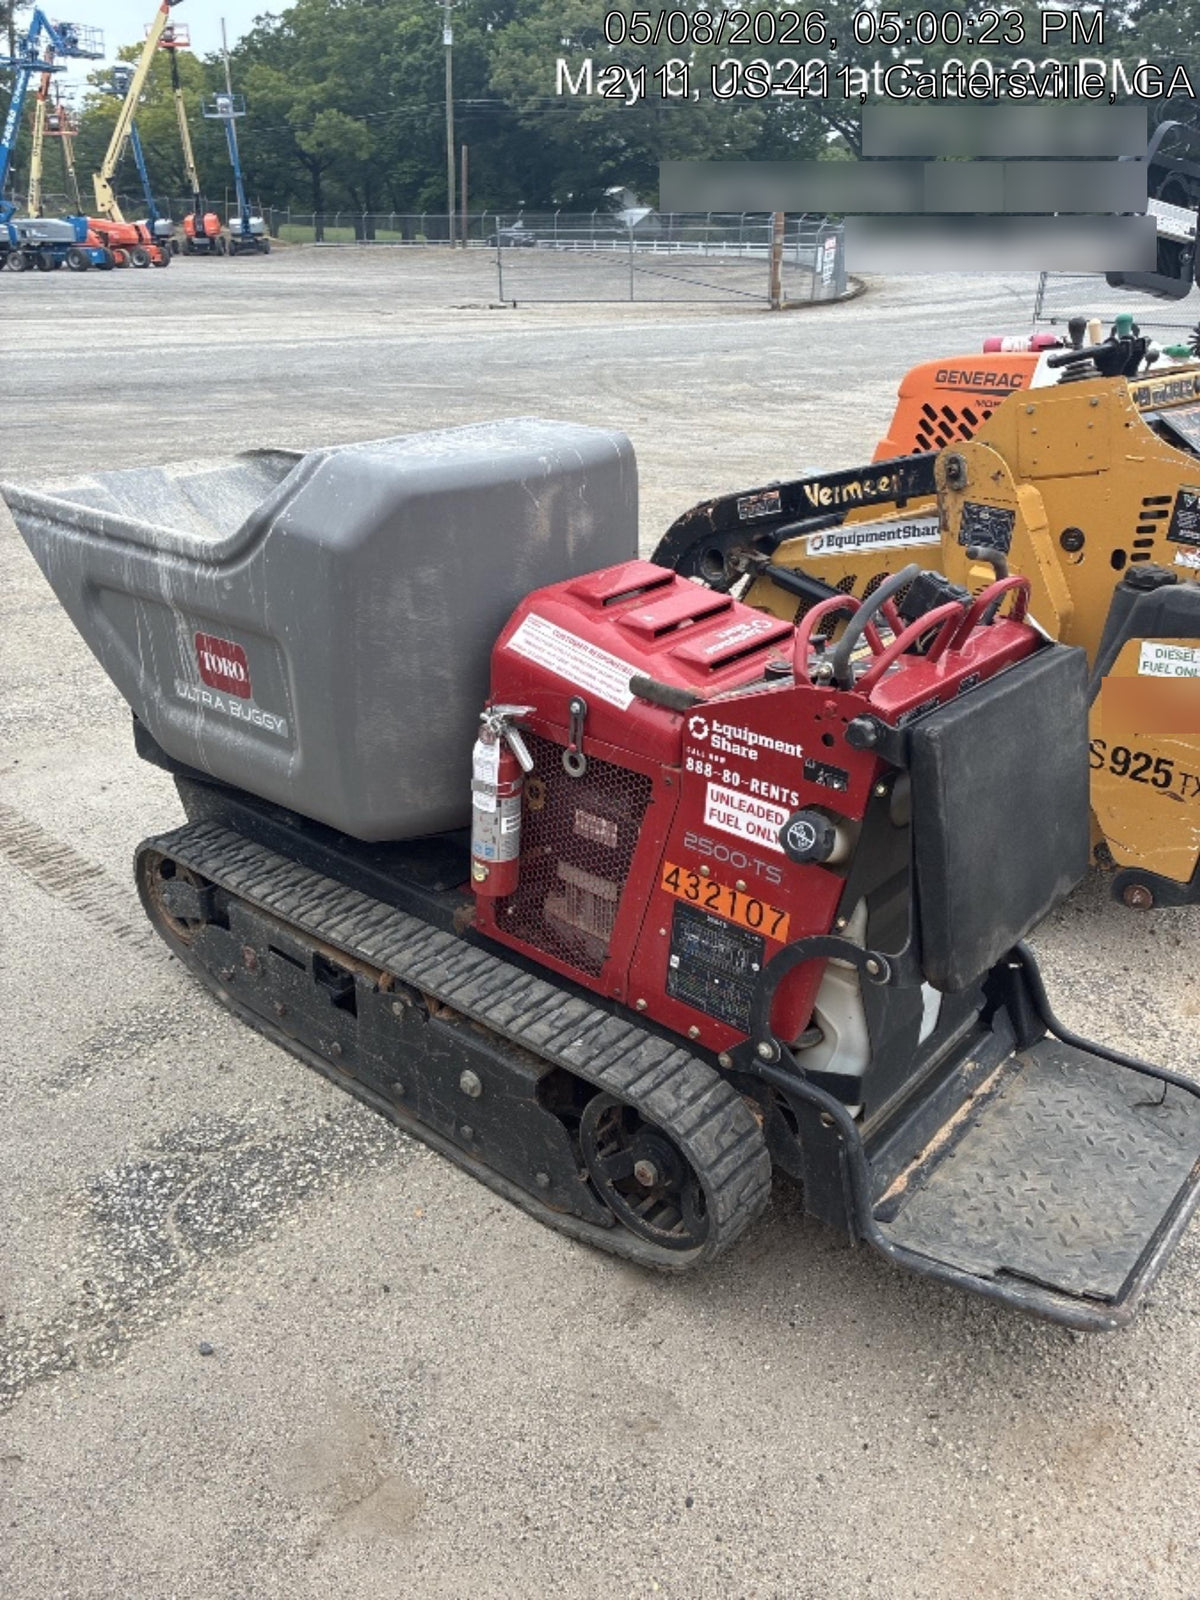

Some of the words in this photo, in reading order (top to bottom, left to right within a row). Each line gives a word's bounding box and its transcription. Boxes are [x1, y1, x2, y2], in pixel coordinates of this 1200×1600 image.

[935, 369, 1024, 388] GENERAC
[200, 650, 246, 681] TORO
[1142, 660, 1172, 674] FUEL
[1155, 648, 1198, 663] DIESEL
[174, 679, 226, 712] ULTRA
[228, 699, 284, 731] BUGGY
[710, 734, 758, 761] Share
[711, 719, 804, 758] Equipment
[709, 788, 785, 826] UNLEADED
[708, 807, 742, 831] FUEL
[746, 821, 780, 845] ONLY
[664, 867, 787, 936] 432107
